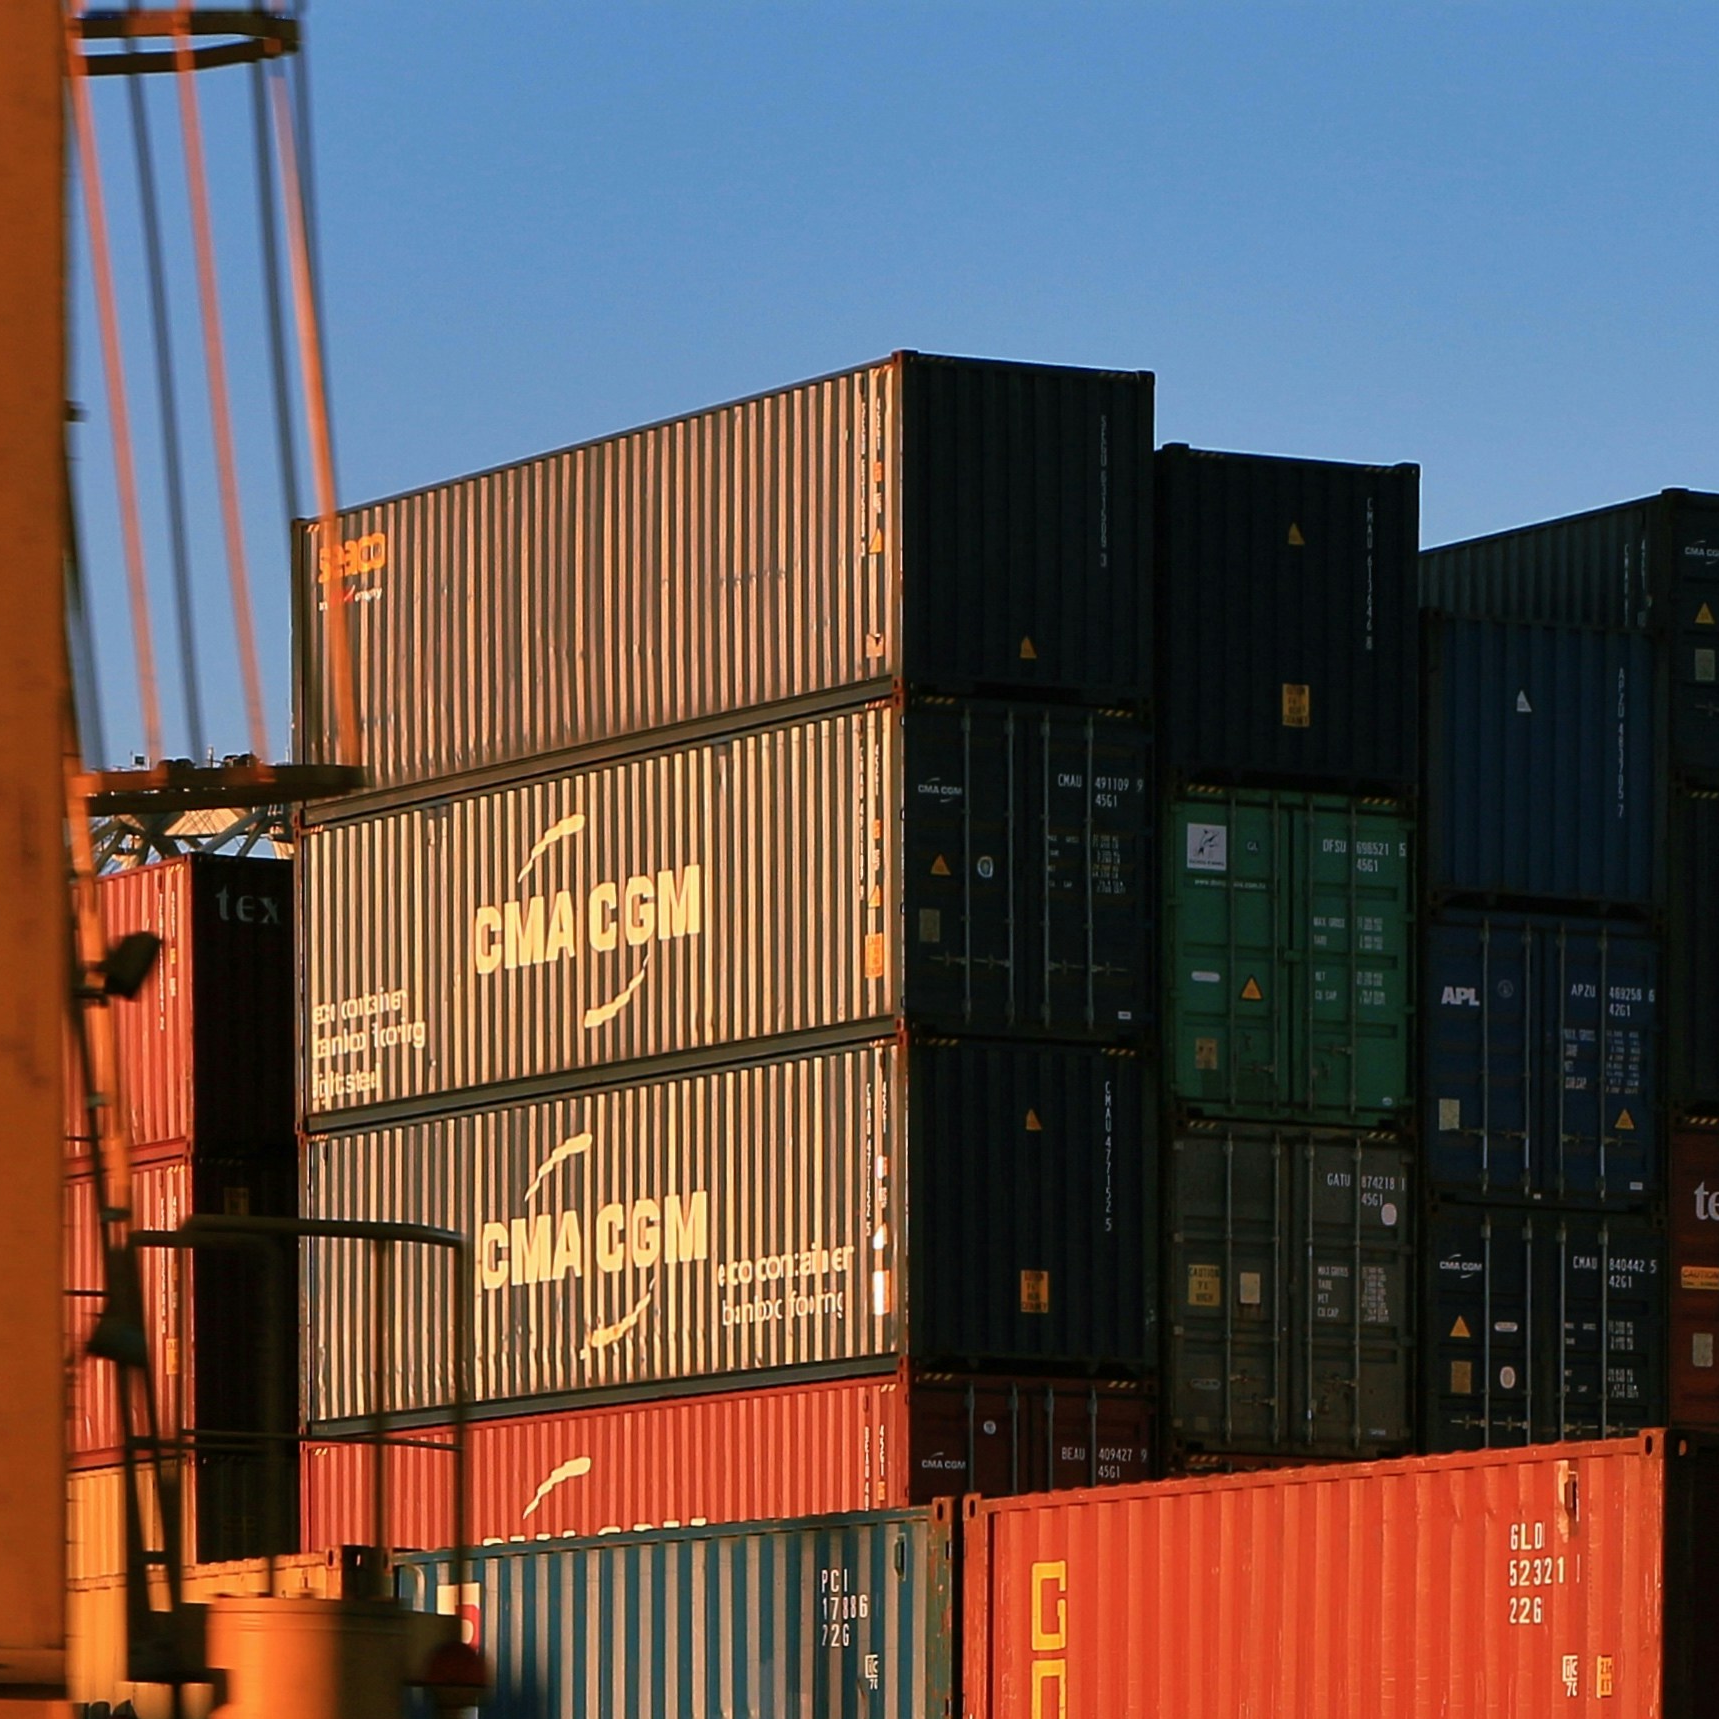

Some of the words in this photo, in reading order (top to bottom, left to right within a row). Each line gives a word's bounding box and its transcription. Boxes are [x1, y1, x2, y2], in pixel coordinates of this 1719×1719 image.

[1366, 497, 1374, 549] CMAU
[1684, 546, 1705, 556] CMA
[1617, 667, 1625, 718] APZU
[918, 783, 940, 795] CMA
[941, 785, 963, 797] CGM
[1057, 773, 1082, 788] CMAU
[1094, 776, 1130, 792] 491109
[1137, 779, 1144, 793] 9
[1094, 793, 1118, 808] 45G1
[1322, 838, 1347, 854] DFSU
[1356, 858, 1379, 873] 45G1
[215, 884, 282, 925] tex
[475, 890, 577, 975] CMA
[588, 864, 701, 954] CGM
[1441, 986, 1481, 1007] APL
[1571, 983, 1596, 998] APZU
[1609, 986, 1642, 1001] 469258
[1648, 988, 1656, 1002] 6
[1609, 1003, 1631, 1017] 42G1
[1103, 1080, 1113, 1132] CMAU
[1103, 1135, 1113, 1214] 477152
[1327, 1173, 1351, 1187] GATU
[1361, 1176, 1395, 1190] 874218
[1361, 1193, 1384, 1206] 45G1
[1103, 1217, 1112, 1232] 5
[481, 1211, 583, 1290] CMA
[595, 1190, 709, 1274] CGM
[1439, 1261, 1460, 1271] CMA
[1461, 1262, 1483, 1272] CGM
[1573, 1255, 1598, 1270] CMAU
[1608, 1258, 1646, 1273] 840442
[1649, 1260, 1658, 1274] 5
[718, 1260, 753, 1288] eco
[1608, 1274, 1633, 1288] 42G1
[1061, 1446, 1086, 1461] BEAU
[1098, 1447, 1133, 1461] 409427
[1141, 1448, 1148, 1463] 9
[921, 1458, 943, 1469] CMA
[944, 1459, 967, 1471] CGM
[1098, 1464, 1121, 1479] 45G1
[1509, 1597, 1543, 1624] 22G
